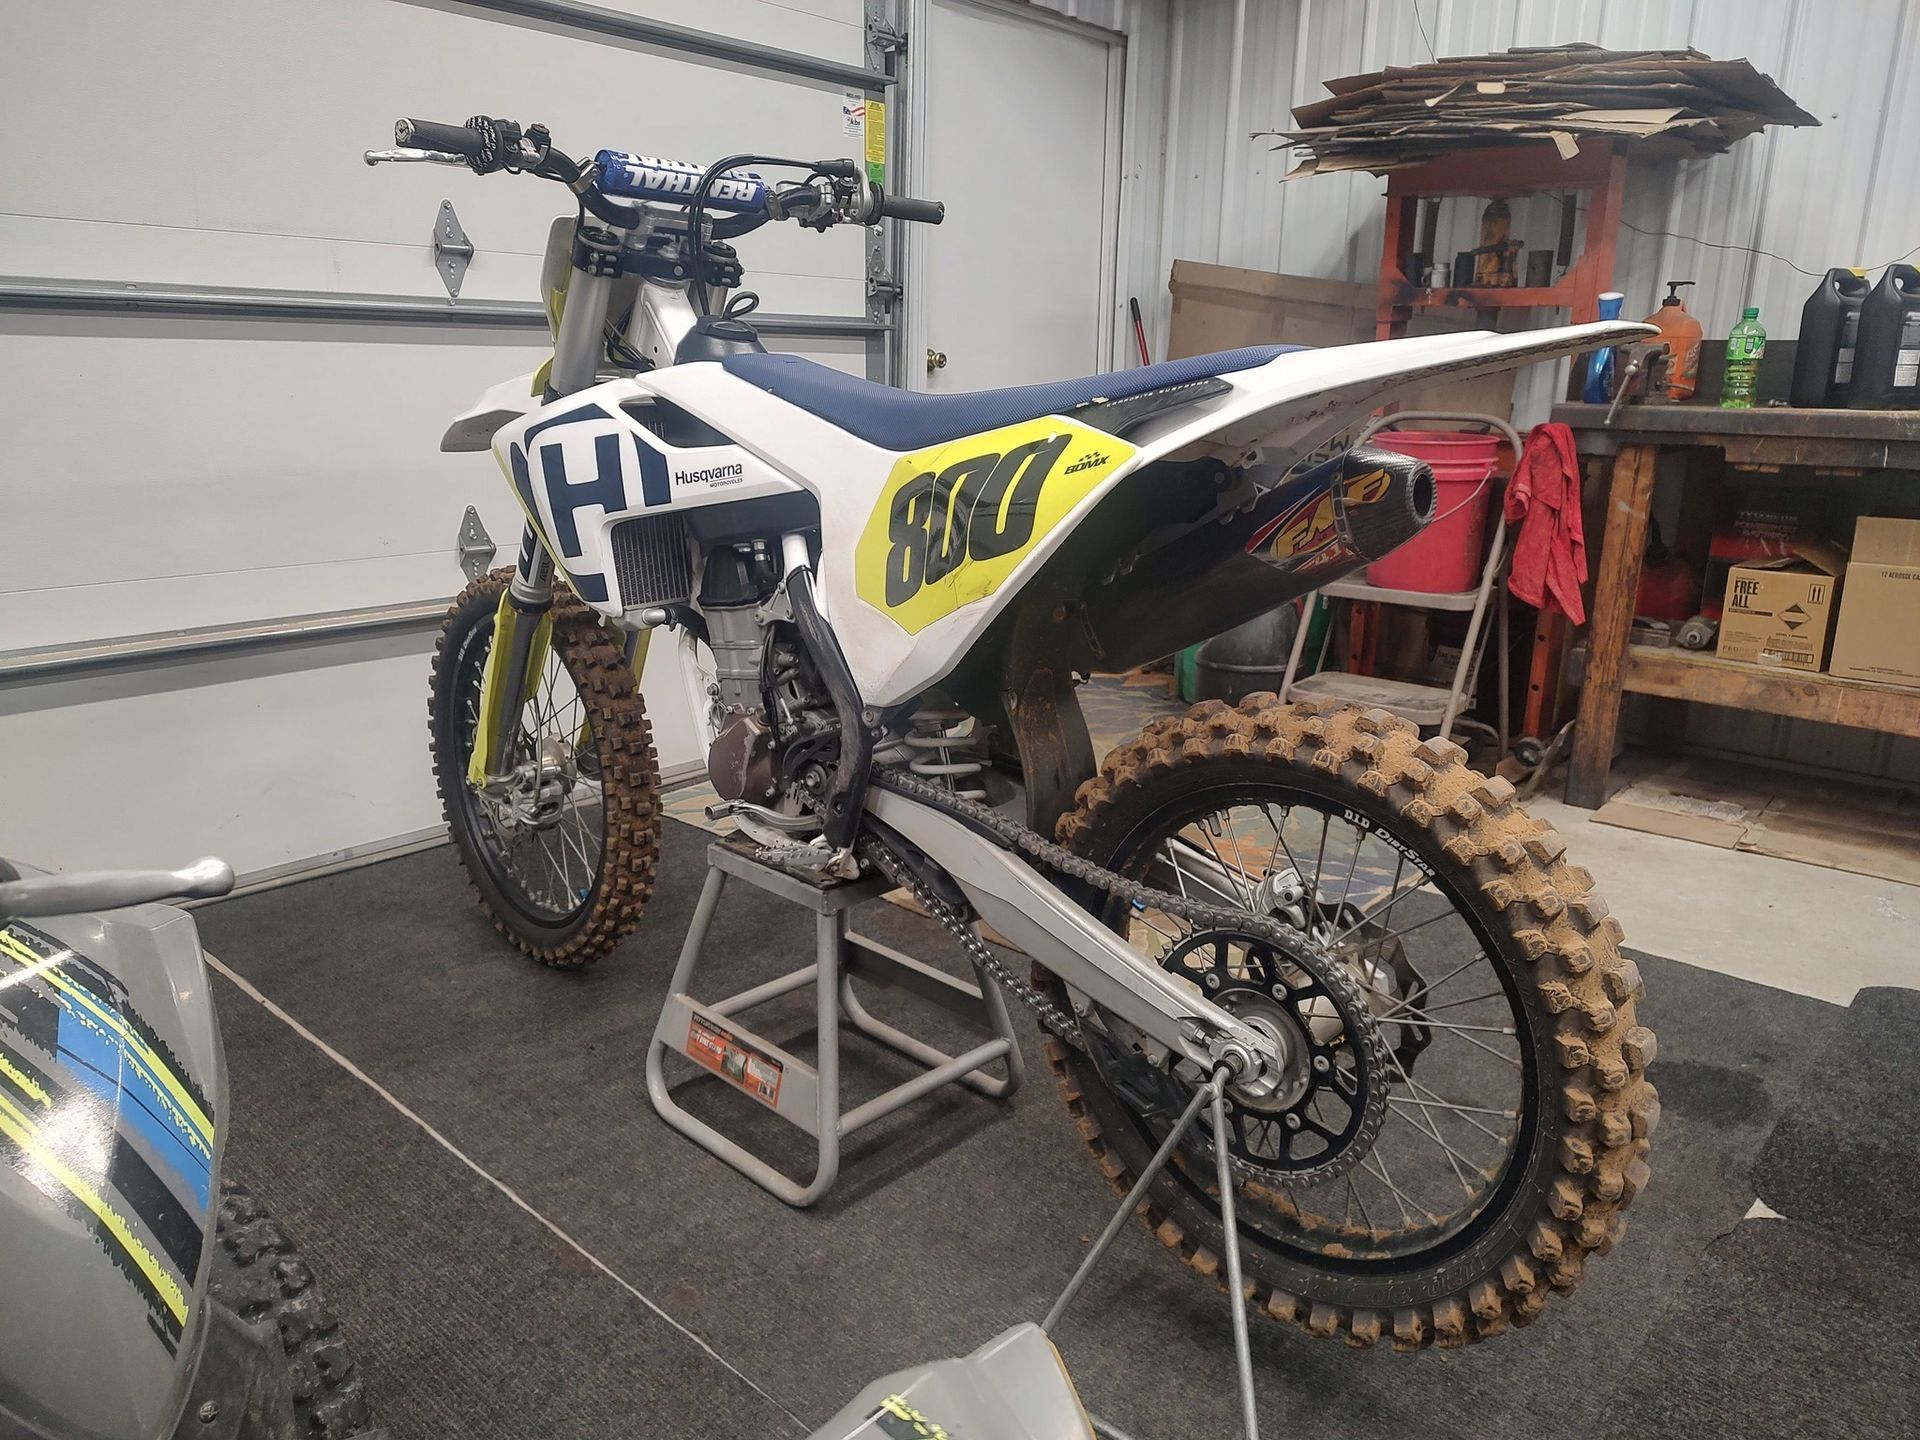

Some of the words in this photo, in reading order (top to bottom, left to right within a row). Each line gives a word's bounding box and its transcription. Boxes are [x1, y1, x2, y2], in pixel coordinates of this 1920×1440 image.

[674, 463, 743, 486] Husqvarna
[709, 478, 744, 488] MOTORCYCLES
[886, 433, 1073, 608] 800
[1734, 580, 1759, 595] FREE
[1731, 594, 1750, 608] ALL
